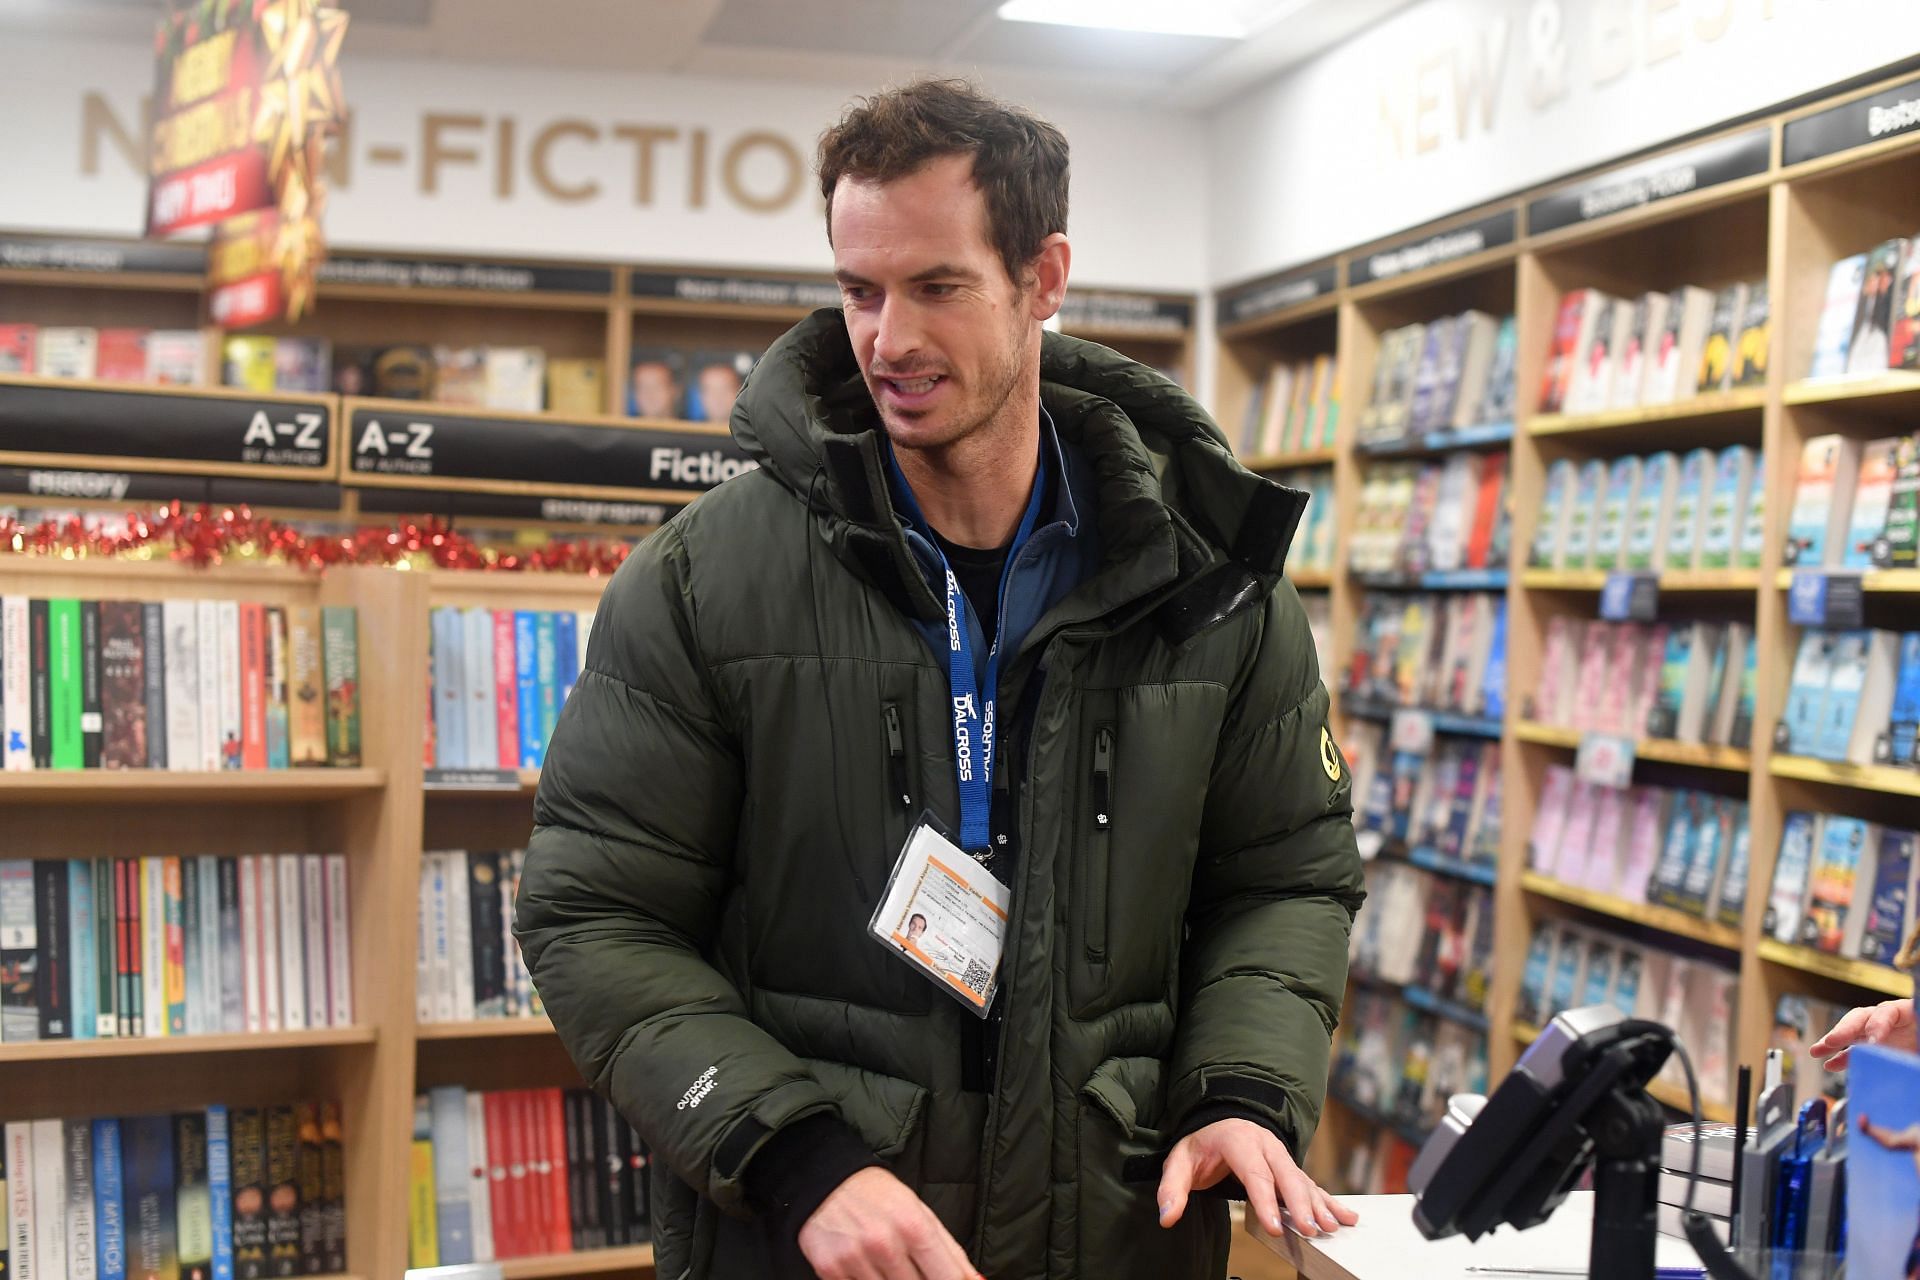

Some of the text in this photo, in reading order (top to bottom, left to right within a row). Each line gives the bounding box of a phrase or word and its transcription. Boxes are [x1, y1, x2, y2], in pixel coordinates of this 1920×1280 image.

[243, 409, 322, 449] A-Z
[357, 419, 434, 458] A-Z
[242, 447, 322, 466] BY AUTHOR
[356, 456, 433, 475] BY AUTHOR
[946, 569, 961, 652] DALCROSS
[953, 695, 973, 782] DALCROSS
[676, 1066, 719, 1110] OUTDOORS
[103, 1200, 122, 1275] MYTHOS
